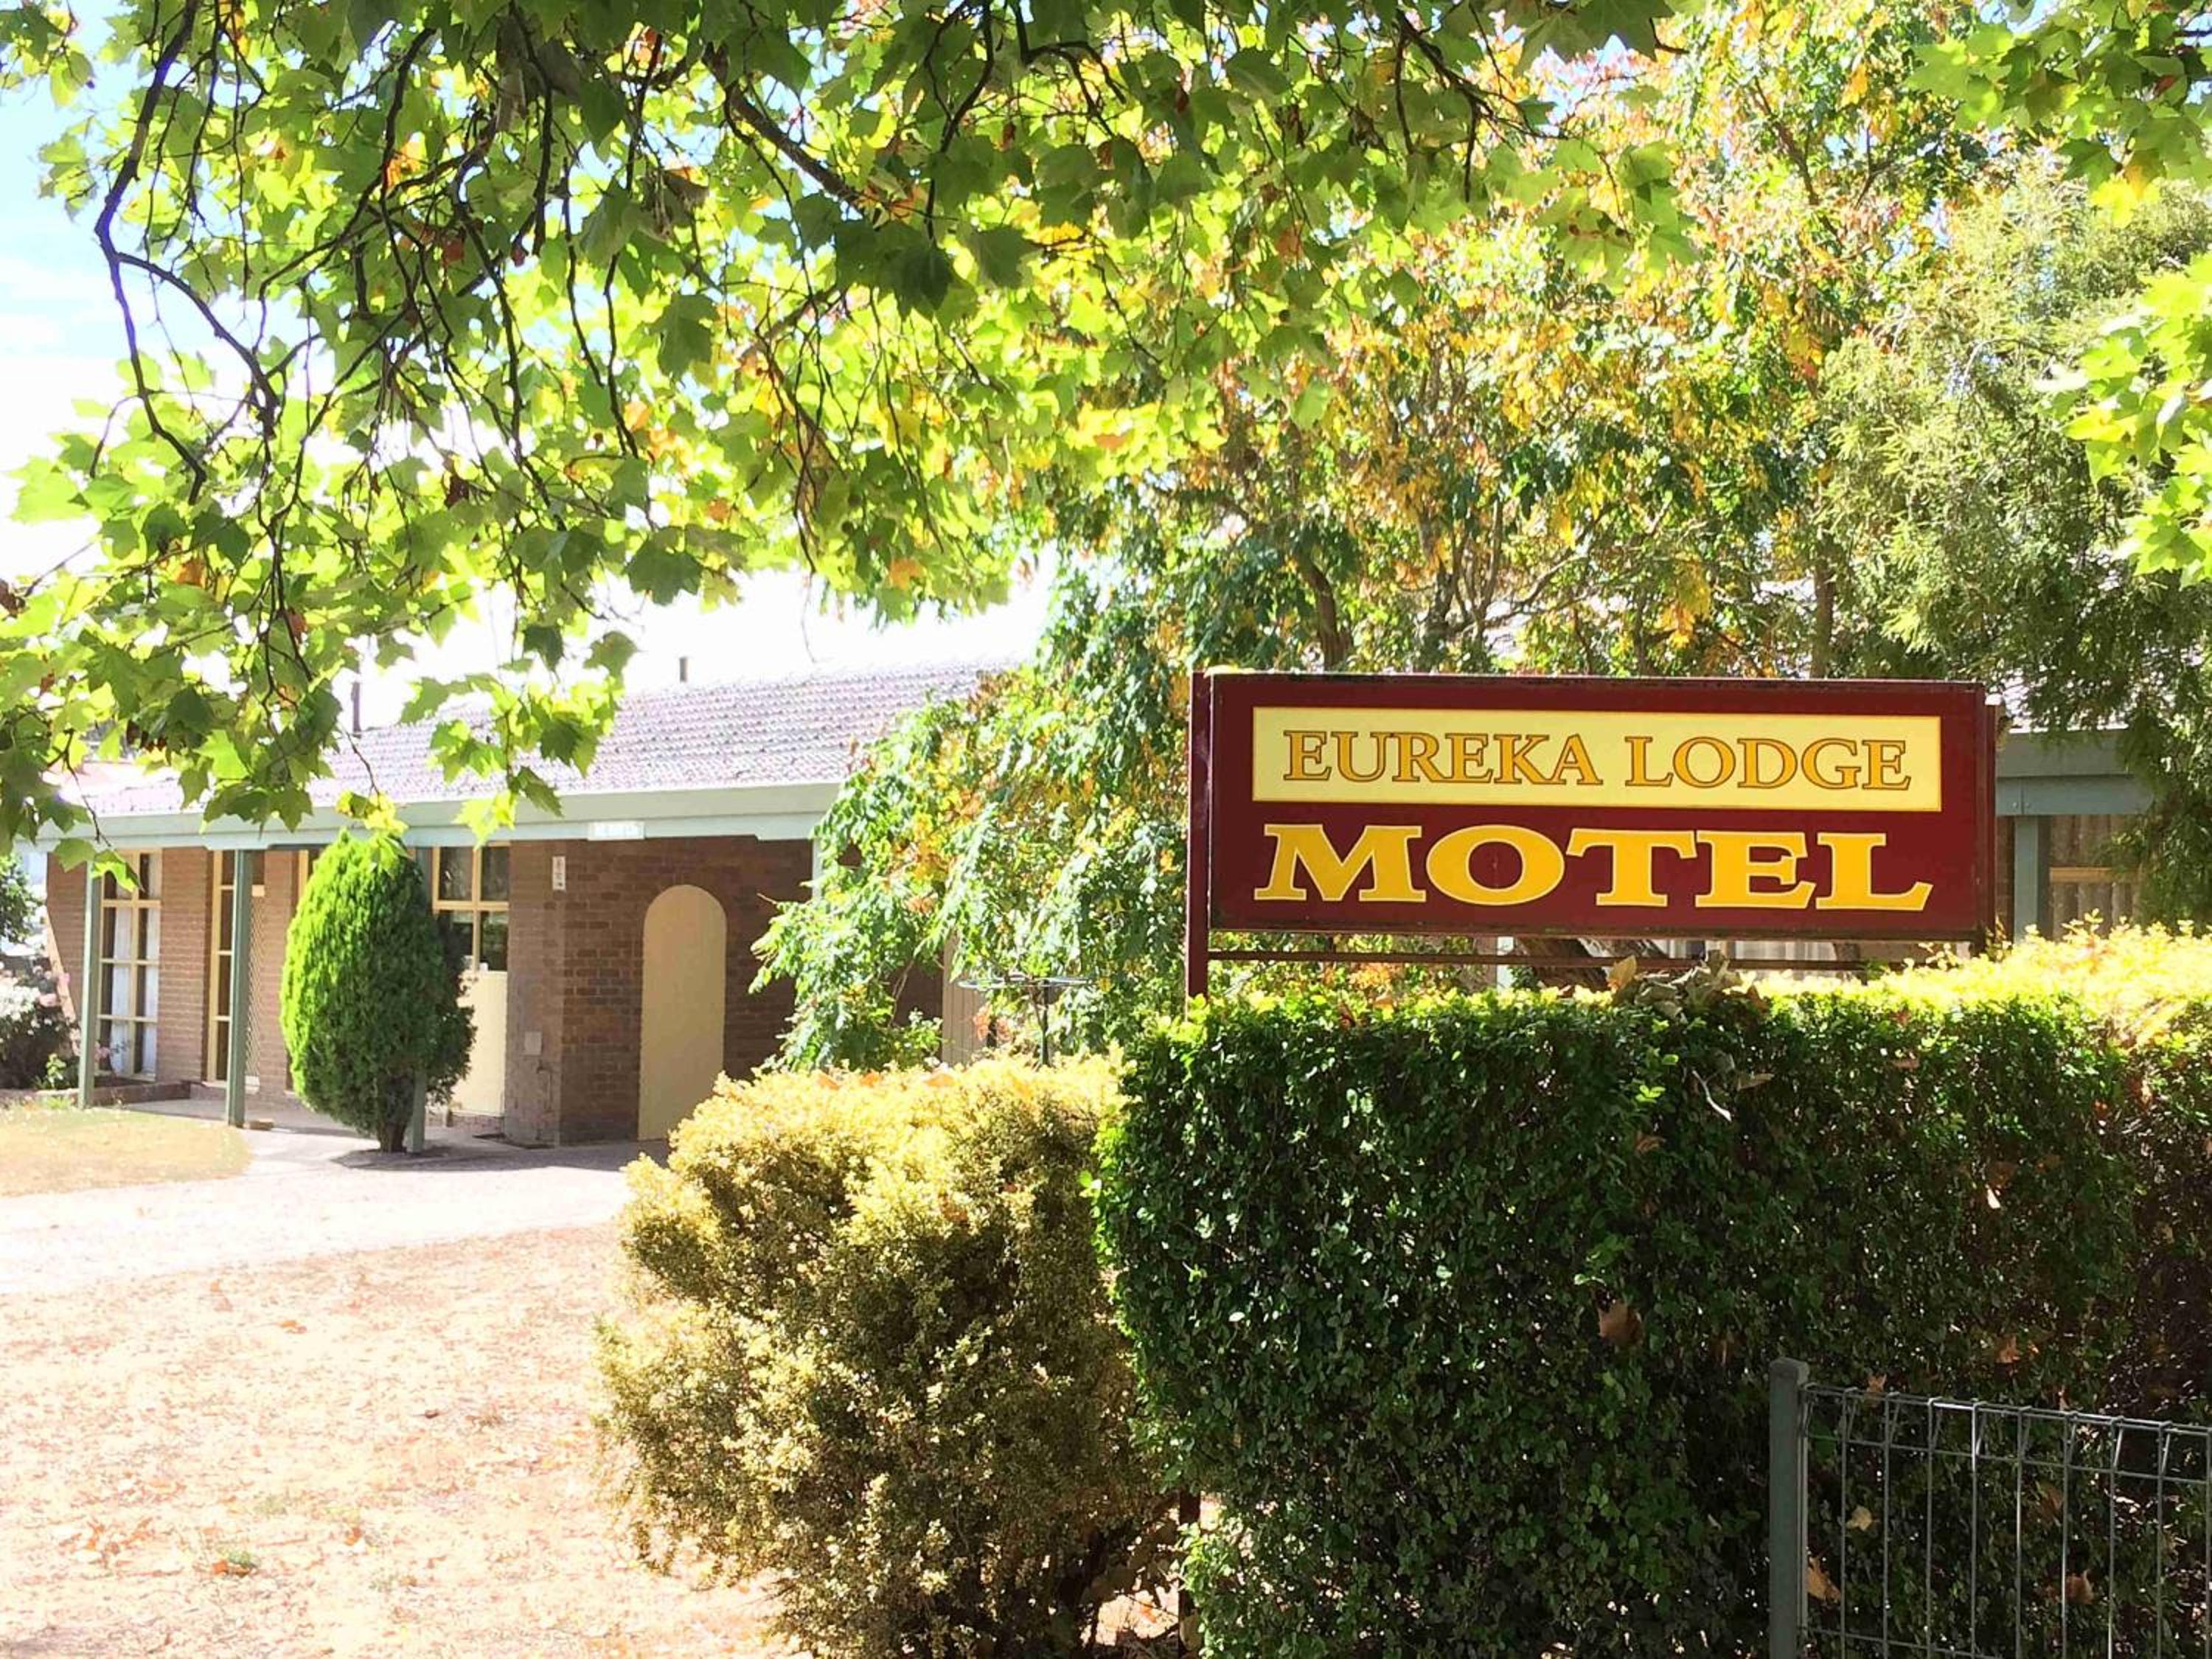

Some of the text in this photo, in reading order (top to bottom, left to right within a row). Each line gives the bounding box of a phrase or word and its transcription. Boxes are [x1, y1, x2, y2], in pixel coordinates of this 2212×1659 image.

[1283, 730, 1911, 791] EUREKA LODGE
[1254, 824, 1933, 911] MOTEL
